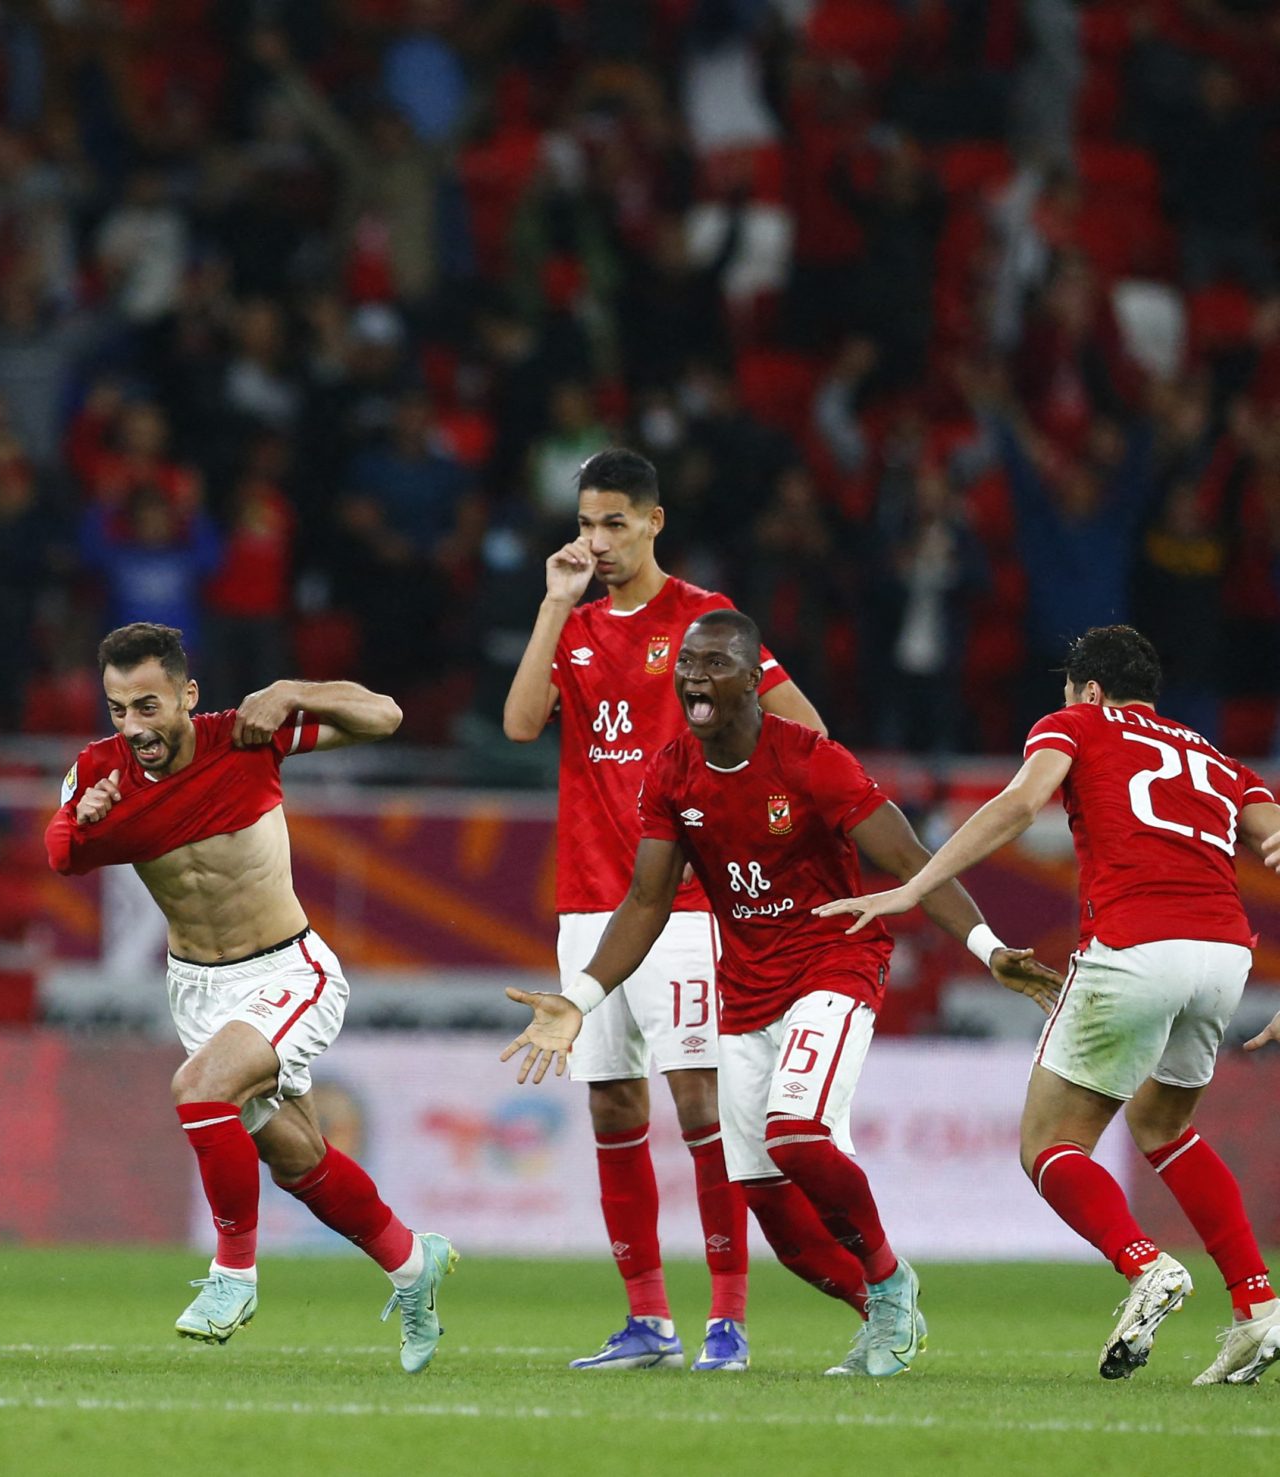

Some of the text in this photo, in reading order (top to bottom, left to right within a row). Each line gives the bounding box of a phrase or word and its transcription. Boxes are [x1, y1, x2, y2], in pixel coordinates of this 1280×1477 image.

[1122, 731, 1238, 857] 25
[732, 898, 794, 919] مرسول
[669, 979, 709, 1029] 13
[779, 1028, 824, 1074] 15
